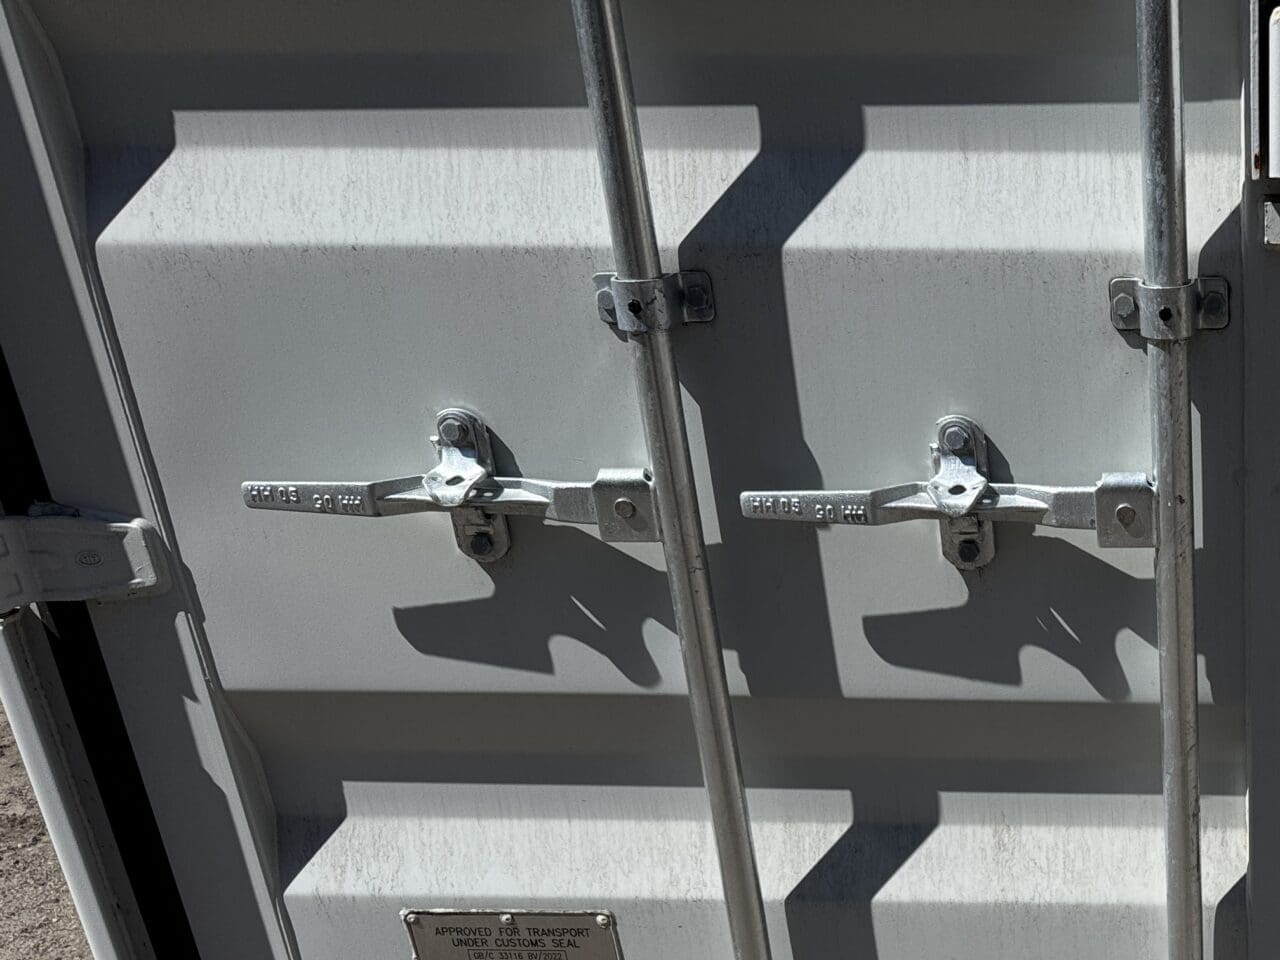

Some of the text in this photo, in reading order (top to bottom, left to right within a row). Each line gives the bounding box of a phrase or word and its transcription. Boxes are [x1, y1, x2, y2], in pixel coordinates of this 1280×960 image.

[435, 927, 591, 938] APPROVED FOR TRANSPORT
[452, 938, 581, 949] UNDER CUSTOMS SEAL
